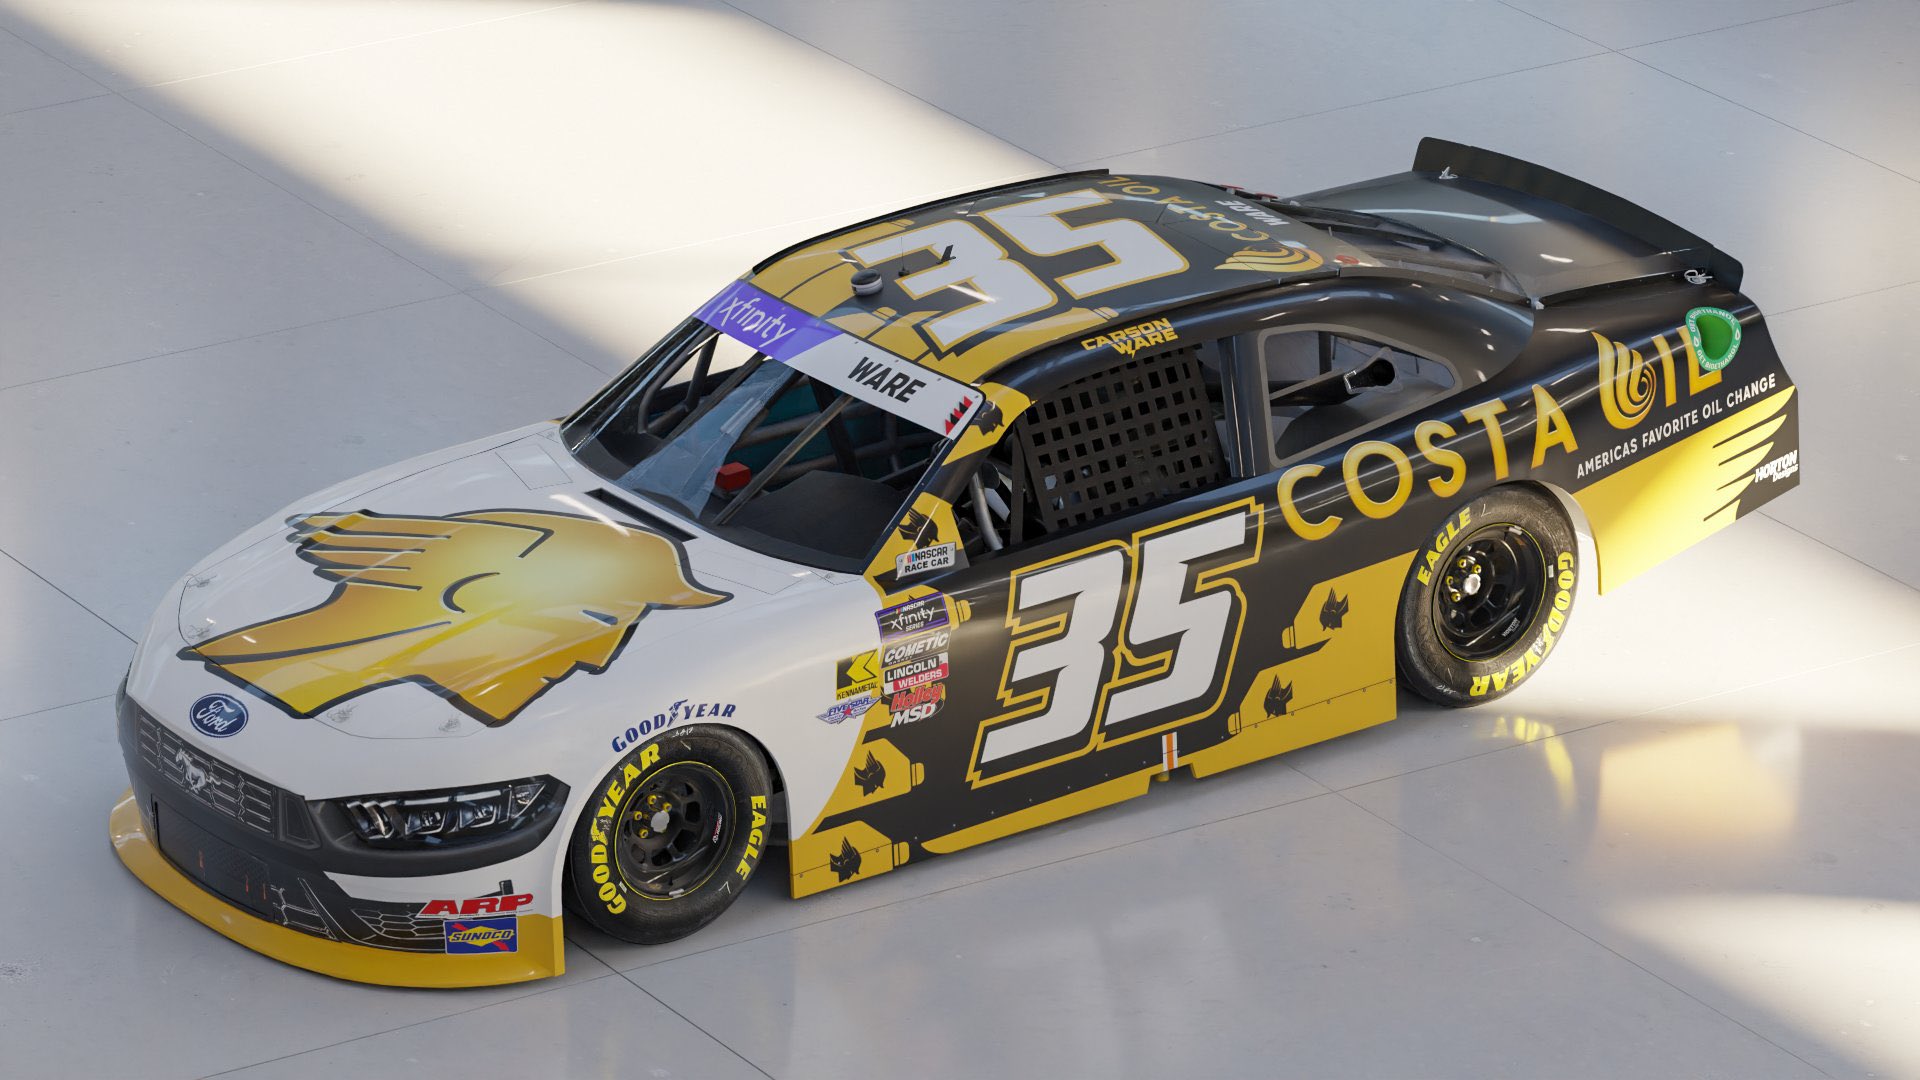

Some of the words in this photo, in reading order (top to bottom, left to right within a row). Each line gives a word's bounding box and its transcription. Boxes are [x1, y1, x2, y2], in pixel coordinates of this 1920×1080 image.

[1098, 176, 1160, 195] OIL
[1159, 195, 1270, 242] COSTA
[1215, 200, 1291, 226] WARE
[848, 188, 1190, 352] 35
[720, 296, 797, 348] xfinity
[1081, 317, 1174, 350] CARSON
[1111, 327, 1179, 358] WARE
[847, 356, 927, 403] WARE
[1577, 438, 1638, 479] AMERICAS
[1642, 409, 1699, 448] FAVORITE
[1702, 401, 1723, 419] OIL
[1726, 372, 1776, 408] CHANGE
[1277, 383, 1578, 541] COSTA
[1754, 449, 1797, 482] HORTON
[912, 546, 948, 563] NASCAR
[1416, 506, 1472, 586] EAGLE
[904, 561, 929, 573] RACE
[931, 556, 949, 567] CAR
[891, 606, 935, 631] xfinity
[1469, 551, 1575, 697] GOODYEAR
[884, 632, 949, 663] COMETIC
[979, 511, 1247, 764] 35
[887, 657, 937, 682] LINCOLN
[898, 669, 943, 689] WELDERS
[836, 681, 879, 700] KENNAMETAL
[891, 683, 944, 712] Holley
[196, 700, 237, 732] Ford
[611, 700, 736, 752] GOODYEAR
[891, 703, 938, 728] MSD
[591, 743, 661, 915] GOODYEAR
[735, 795, 767, 881] EAGLE
[420, 893, 533, 915] ARP
[452, 929, 513, 941] SUNOCO
